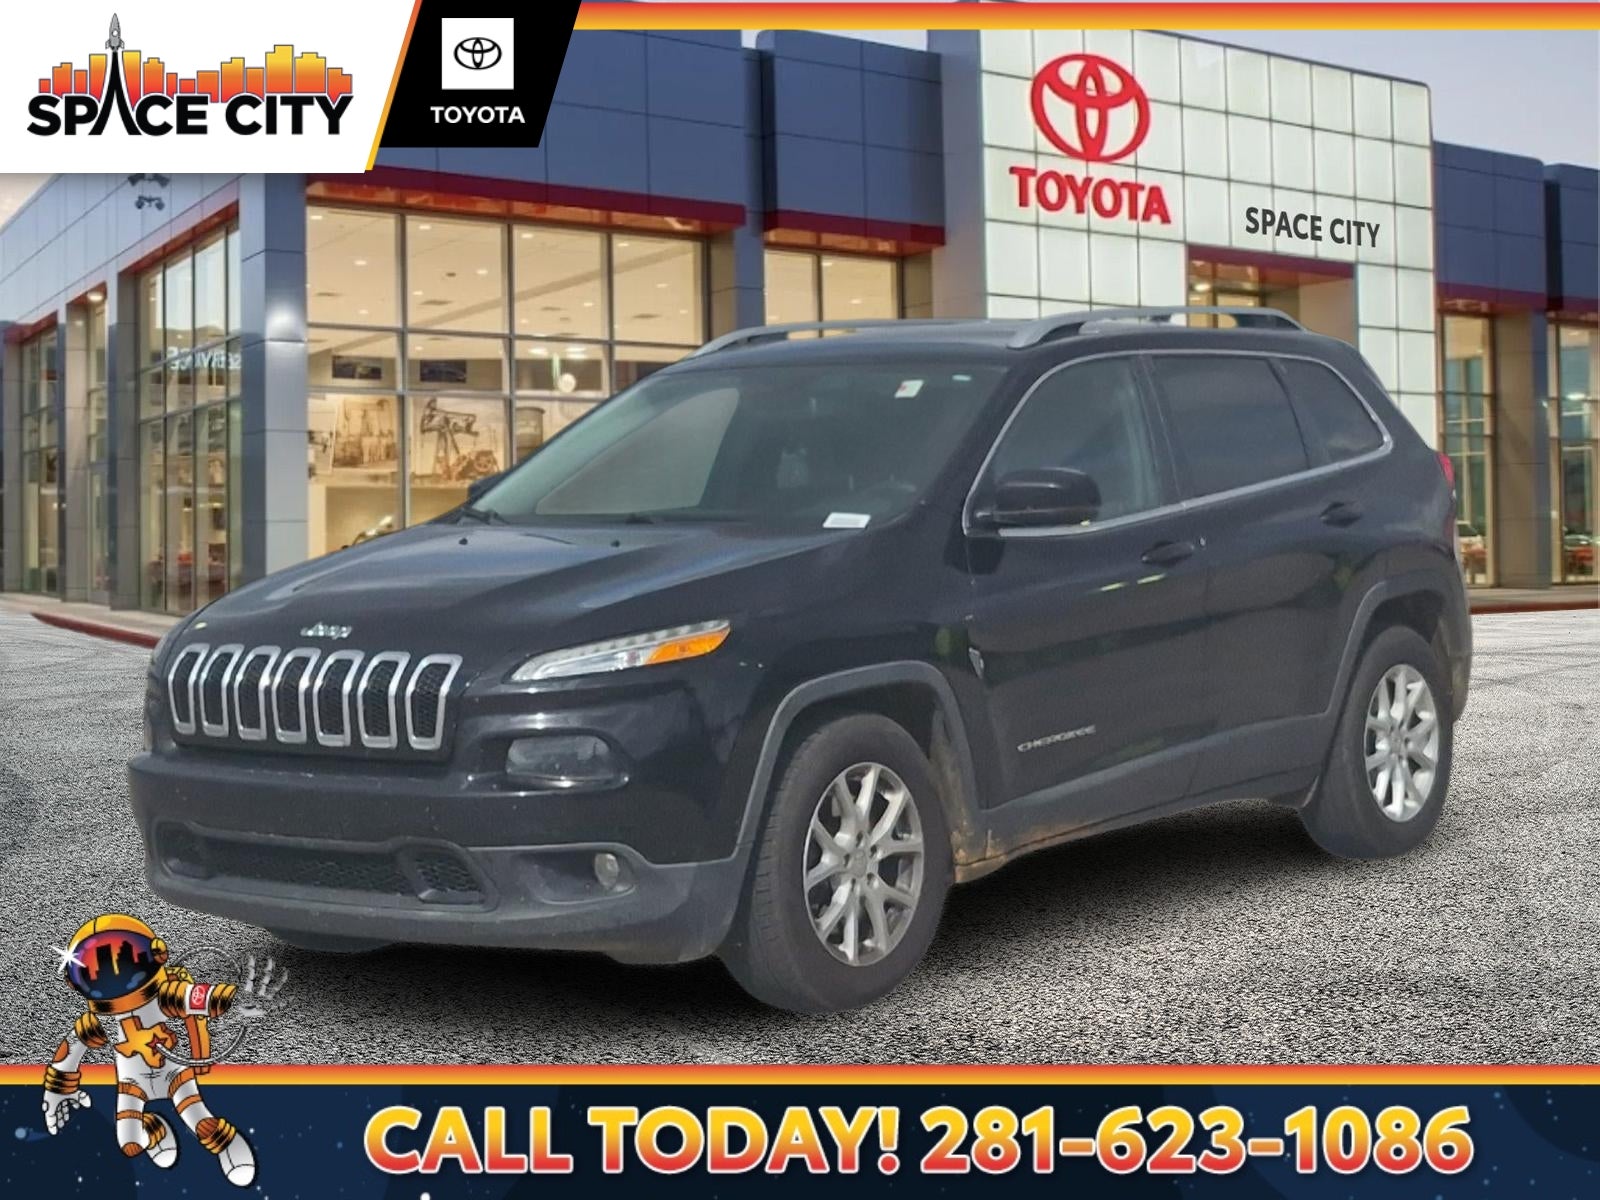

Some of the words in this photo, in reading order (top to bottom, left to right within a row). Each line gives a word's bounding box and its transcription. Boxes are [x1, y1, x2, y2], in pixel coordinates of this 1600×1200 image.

[1009, 166, 1171, 225] TOYOTA
[1245, 207, 1322, 242] SPACE
[1329, 218, 1381, 248] CITY
